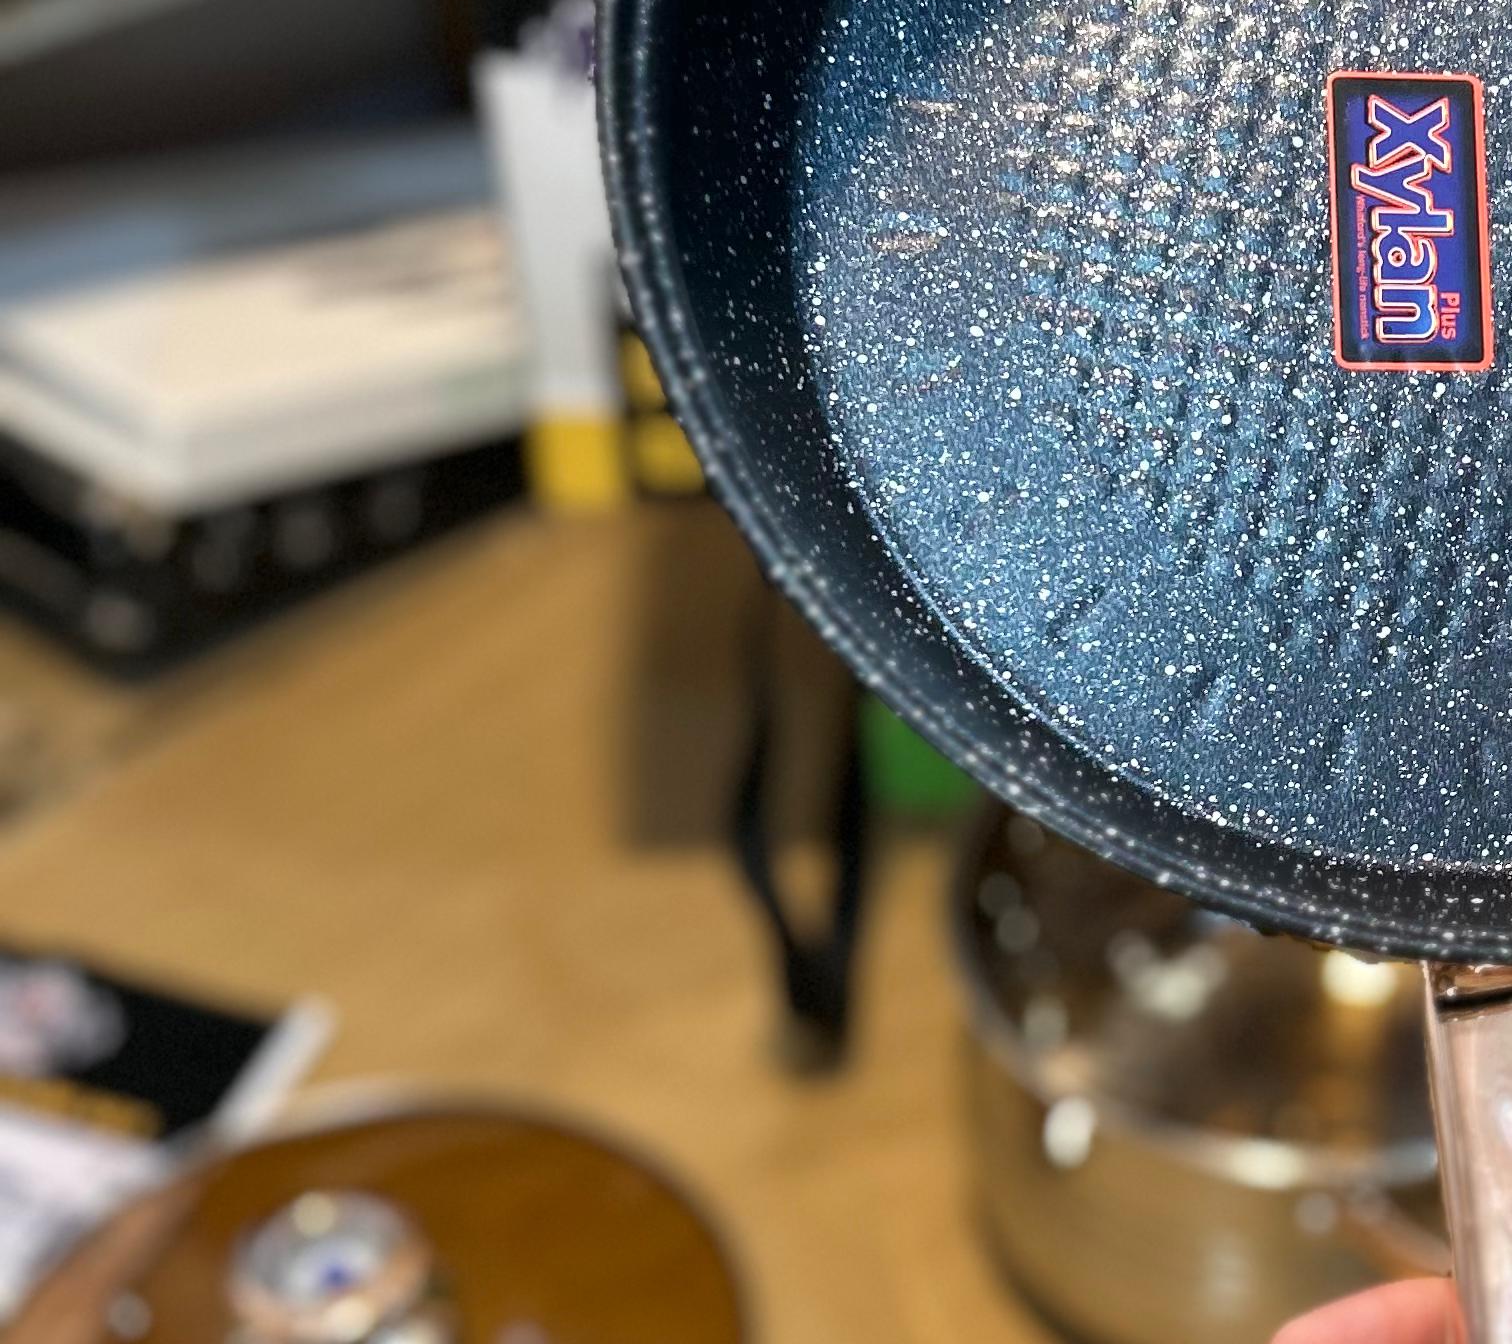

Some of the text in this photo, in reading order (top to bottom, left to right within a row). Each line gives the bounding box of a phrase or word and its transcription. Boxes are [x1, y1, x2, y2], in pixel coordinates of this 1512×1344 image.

[1351, 94, 1454, 343] Xylan
[1359, 294, 1371, 340] nonstick
[1440, 291, 1460, 340] Plus
